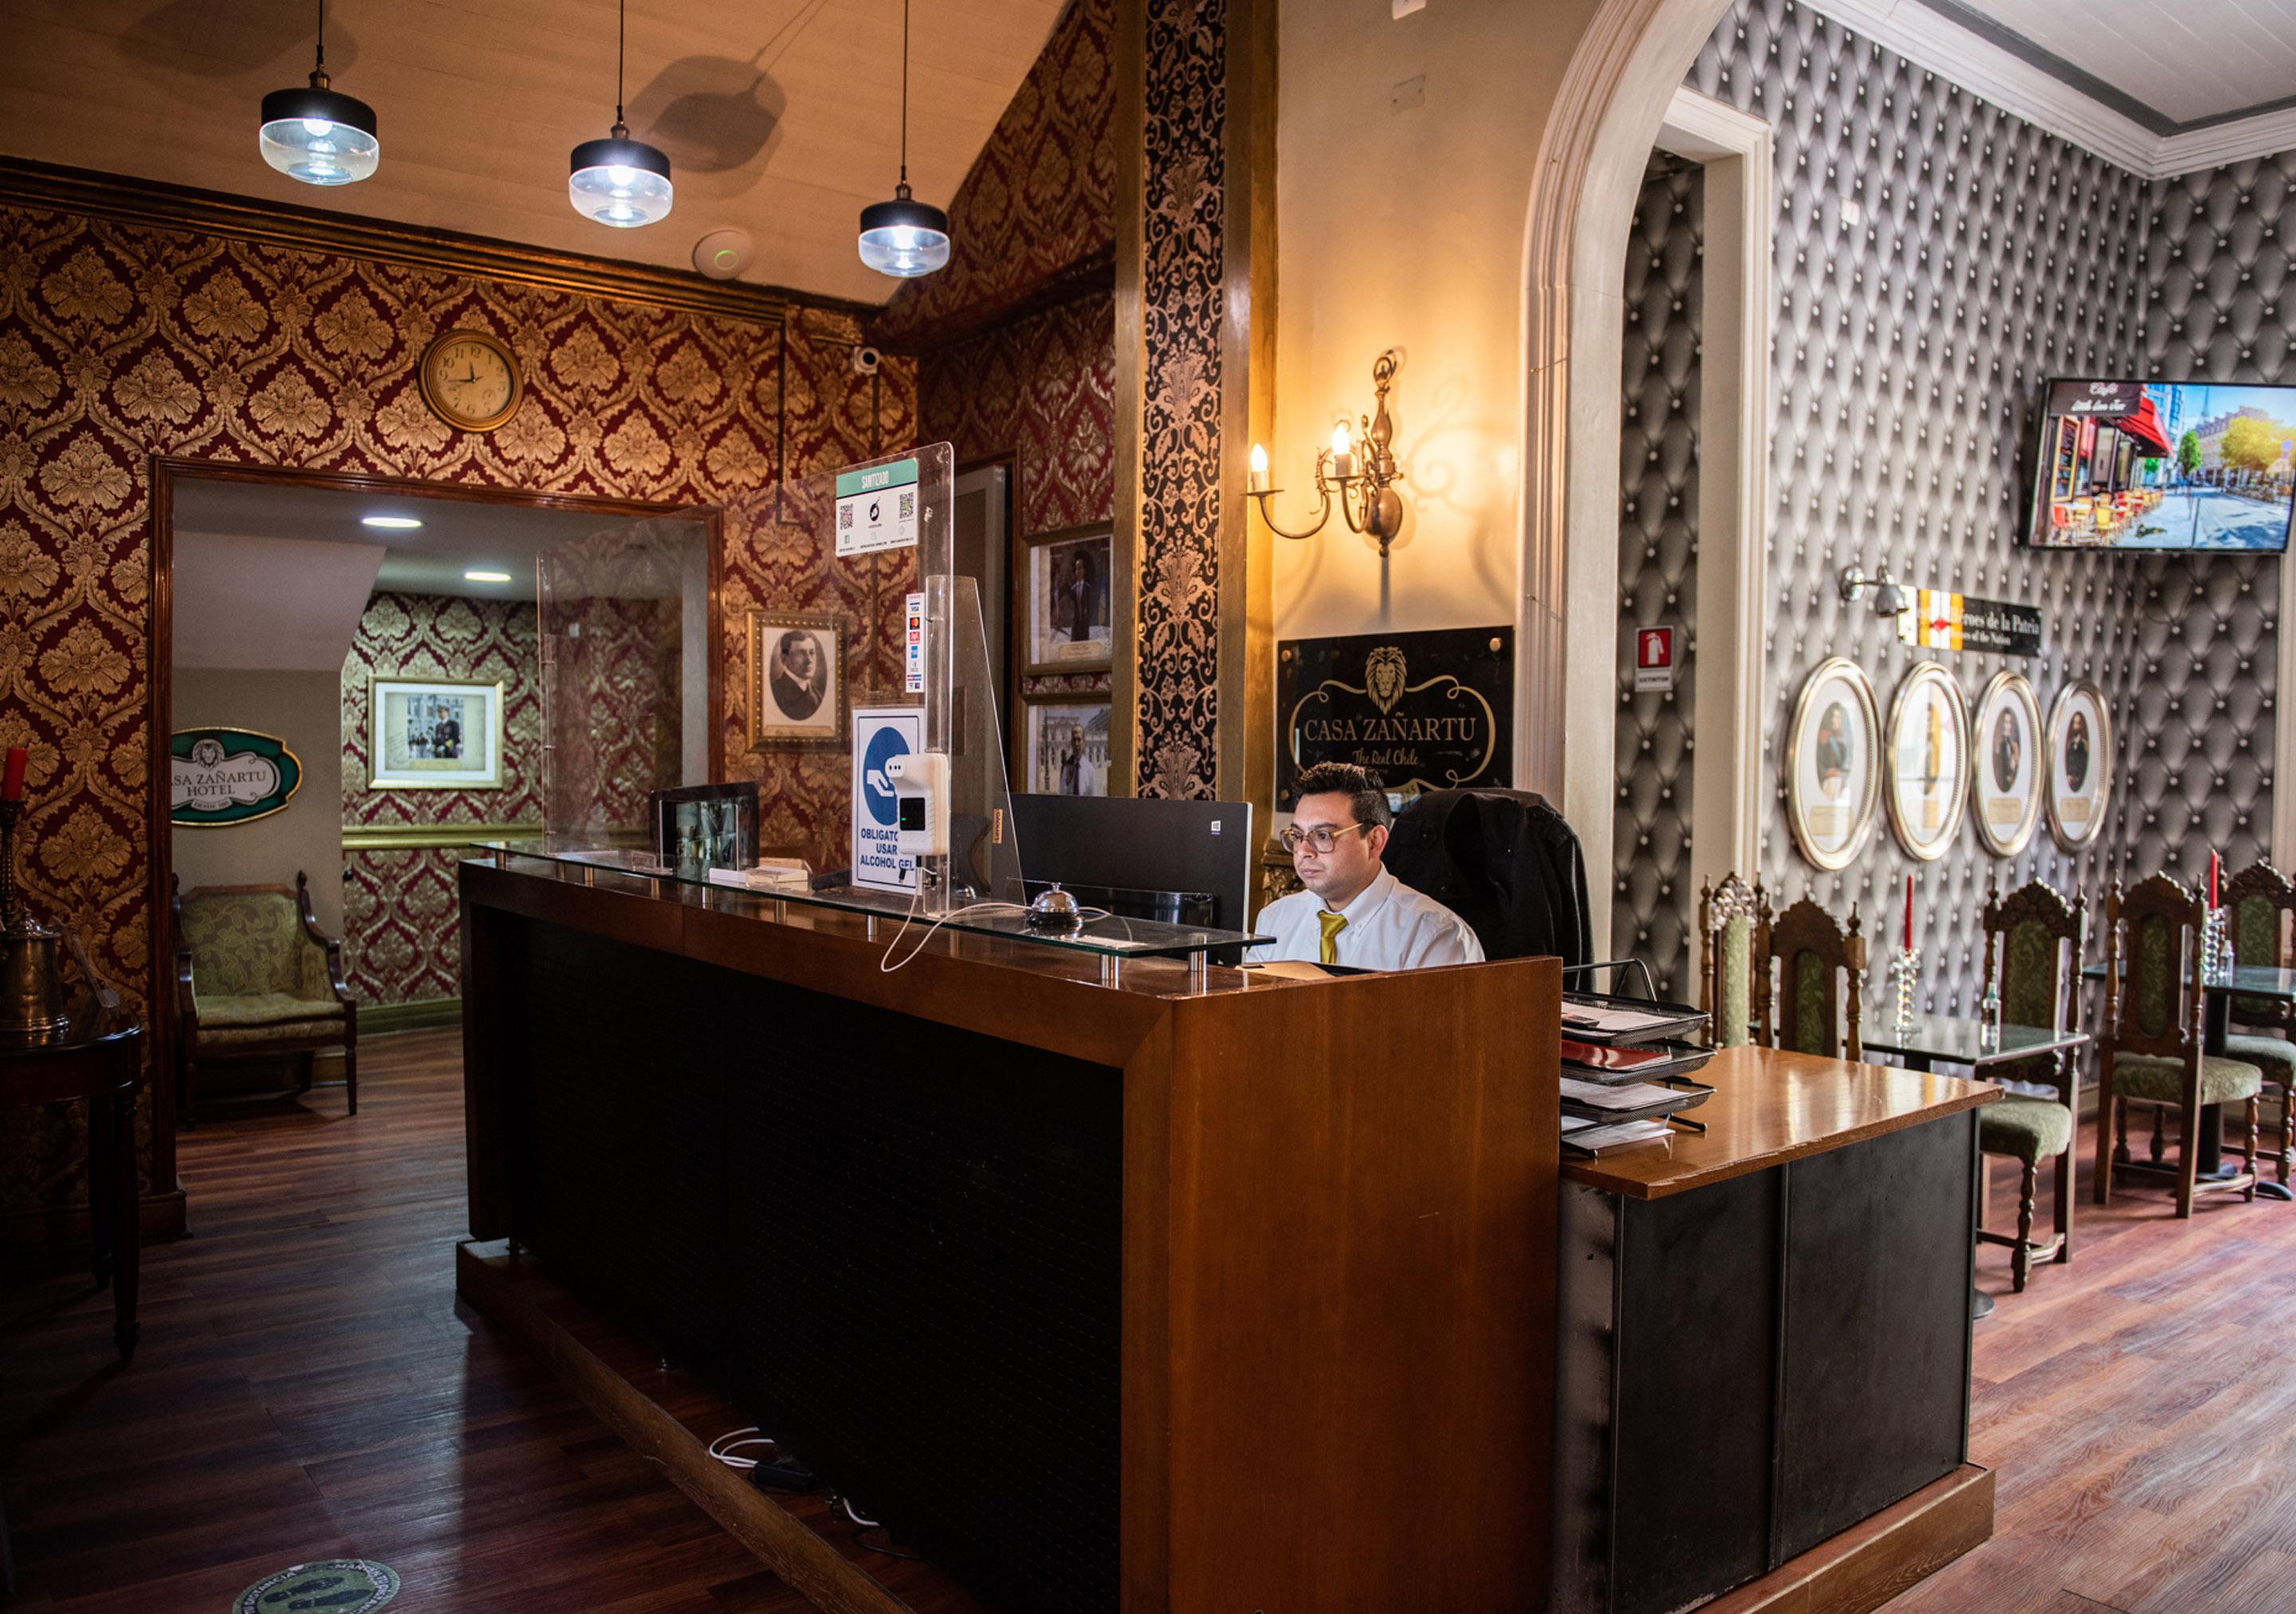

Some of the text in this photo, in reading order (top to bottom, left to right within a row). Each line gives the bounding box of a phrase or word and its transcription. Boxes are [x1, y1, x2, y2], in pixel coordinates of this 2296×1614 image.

[456, 348, 464, 359] 11
[470, 346, 482, 358] 12
[489, 354, 492, 364] 1
[443, 356, 454, 368] 10
[439, 369, 448, 380] 9
[861, 470, 890, 489] SANITIZADO
[1987, 611, 2000, 630] de
[2000, 611, 2011, 633] la
[2012, 613, 2040, 634] Patria
[1305, 713, 1476, 741] CASA ZAÑARTU
[1352, 746, 1420, 766] The Real Chile
[171, 771, 266, 787] SA ZAÑARTU
[187, 784, 236, 797] HOTEL
[861, 827, 898, 842] OBLIGATO
[876, 842, 898, 856] USAR
[860, 854, 897, 869] ALCOHOL
